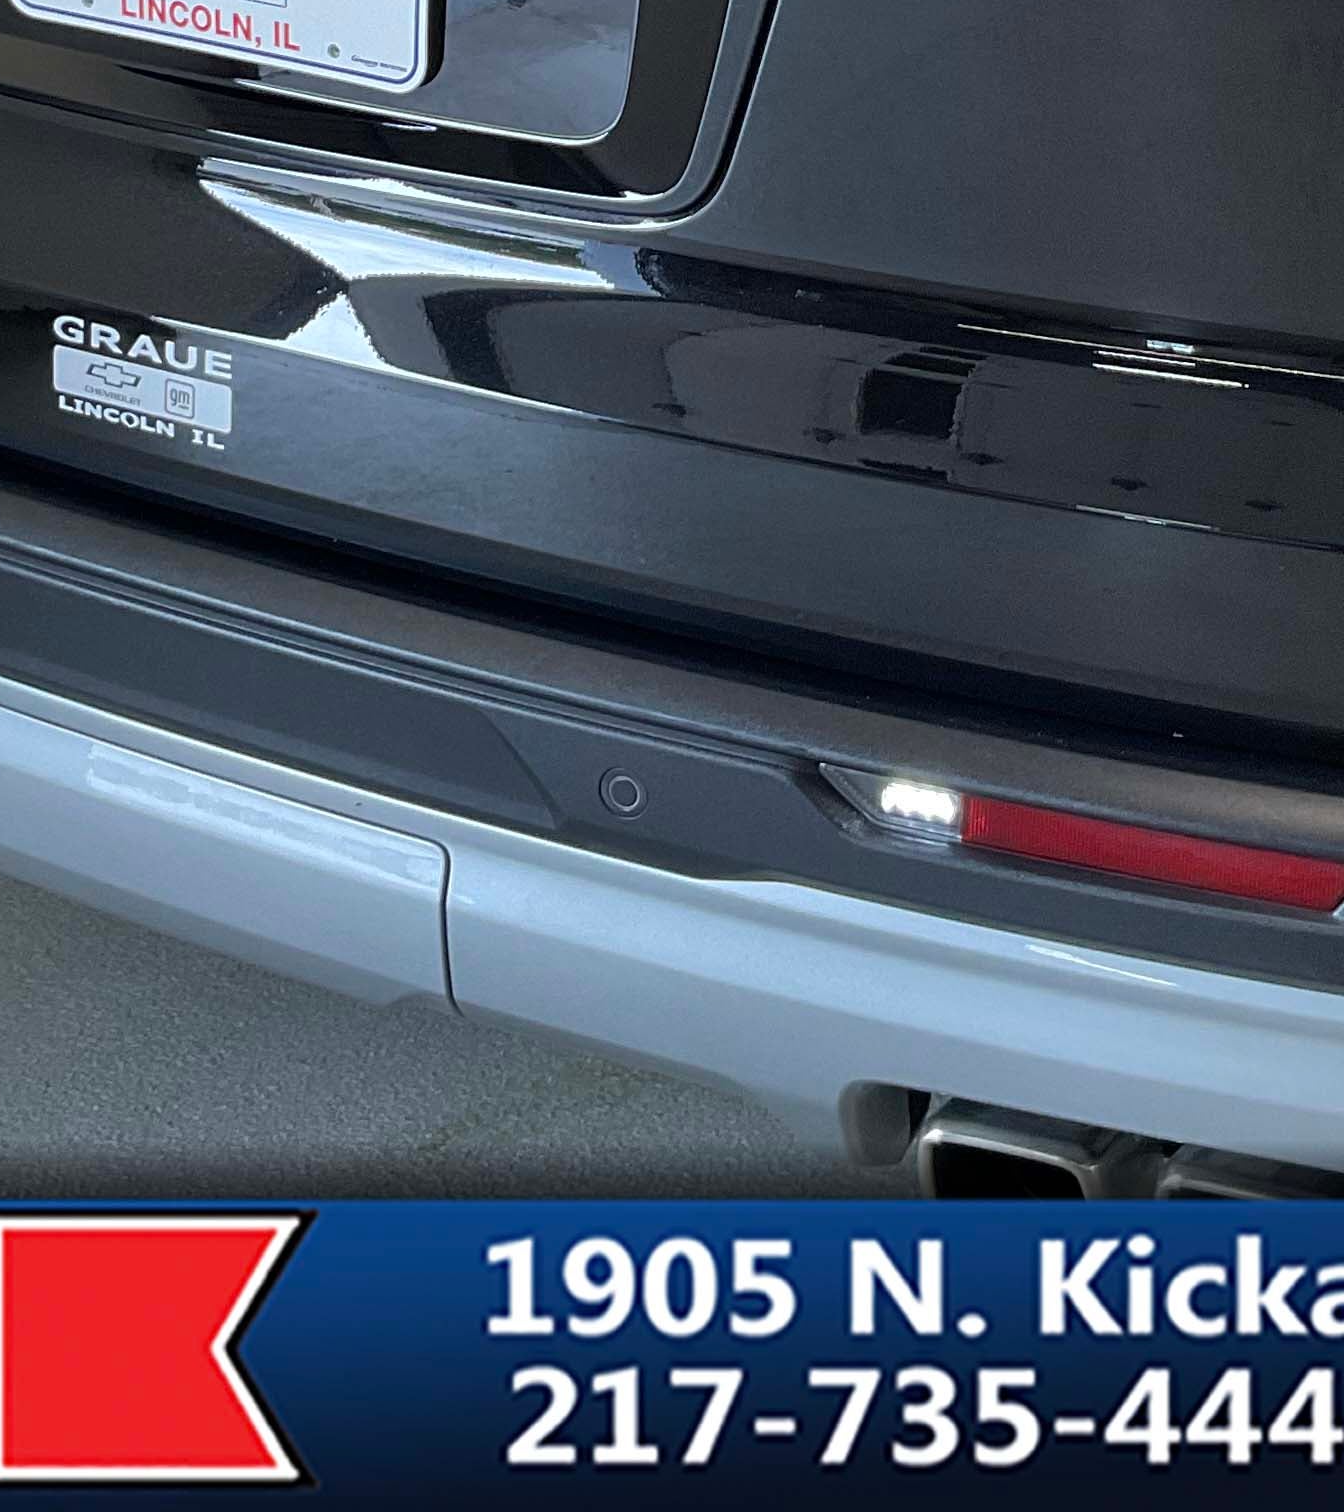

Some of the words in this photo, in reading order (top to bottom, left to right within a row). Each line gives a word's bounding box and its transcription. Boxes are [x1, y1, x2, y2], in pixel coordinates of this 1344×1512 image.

[273, 21, 301, 51] IL
[53, 315, 233, 380] GRAUE
[84, 384, 141, 407] CHEVROLET
[169, 386, 190, 407] gm
[58, 394, 175, 438] LINCOLN
[192, 428, 225, 450] IL
